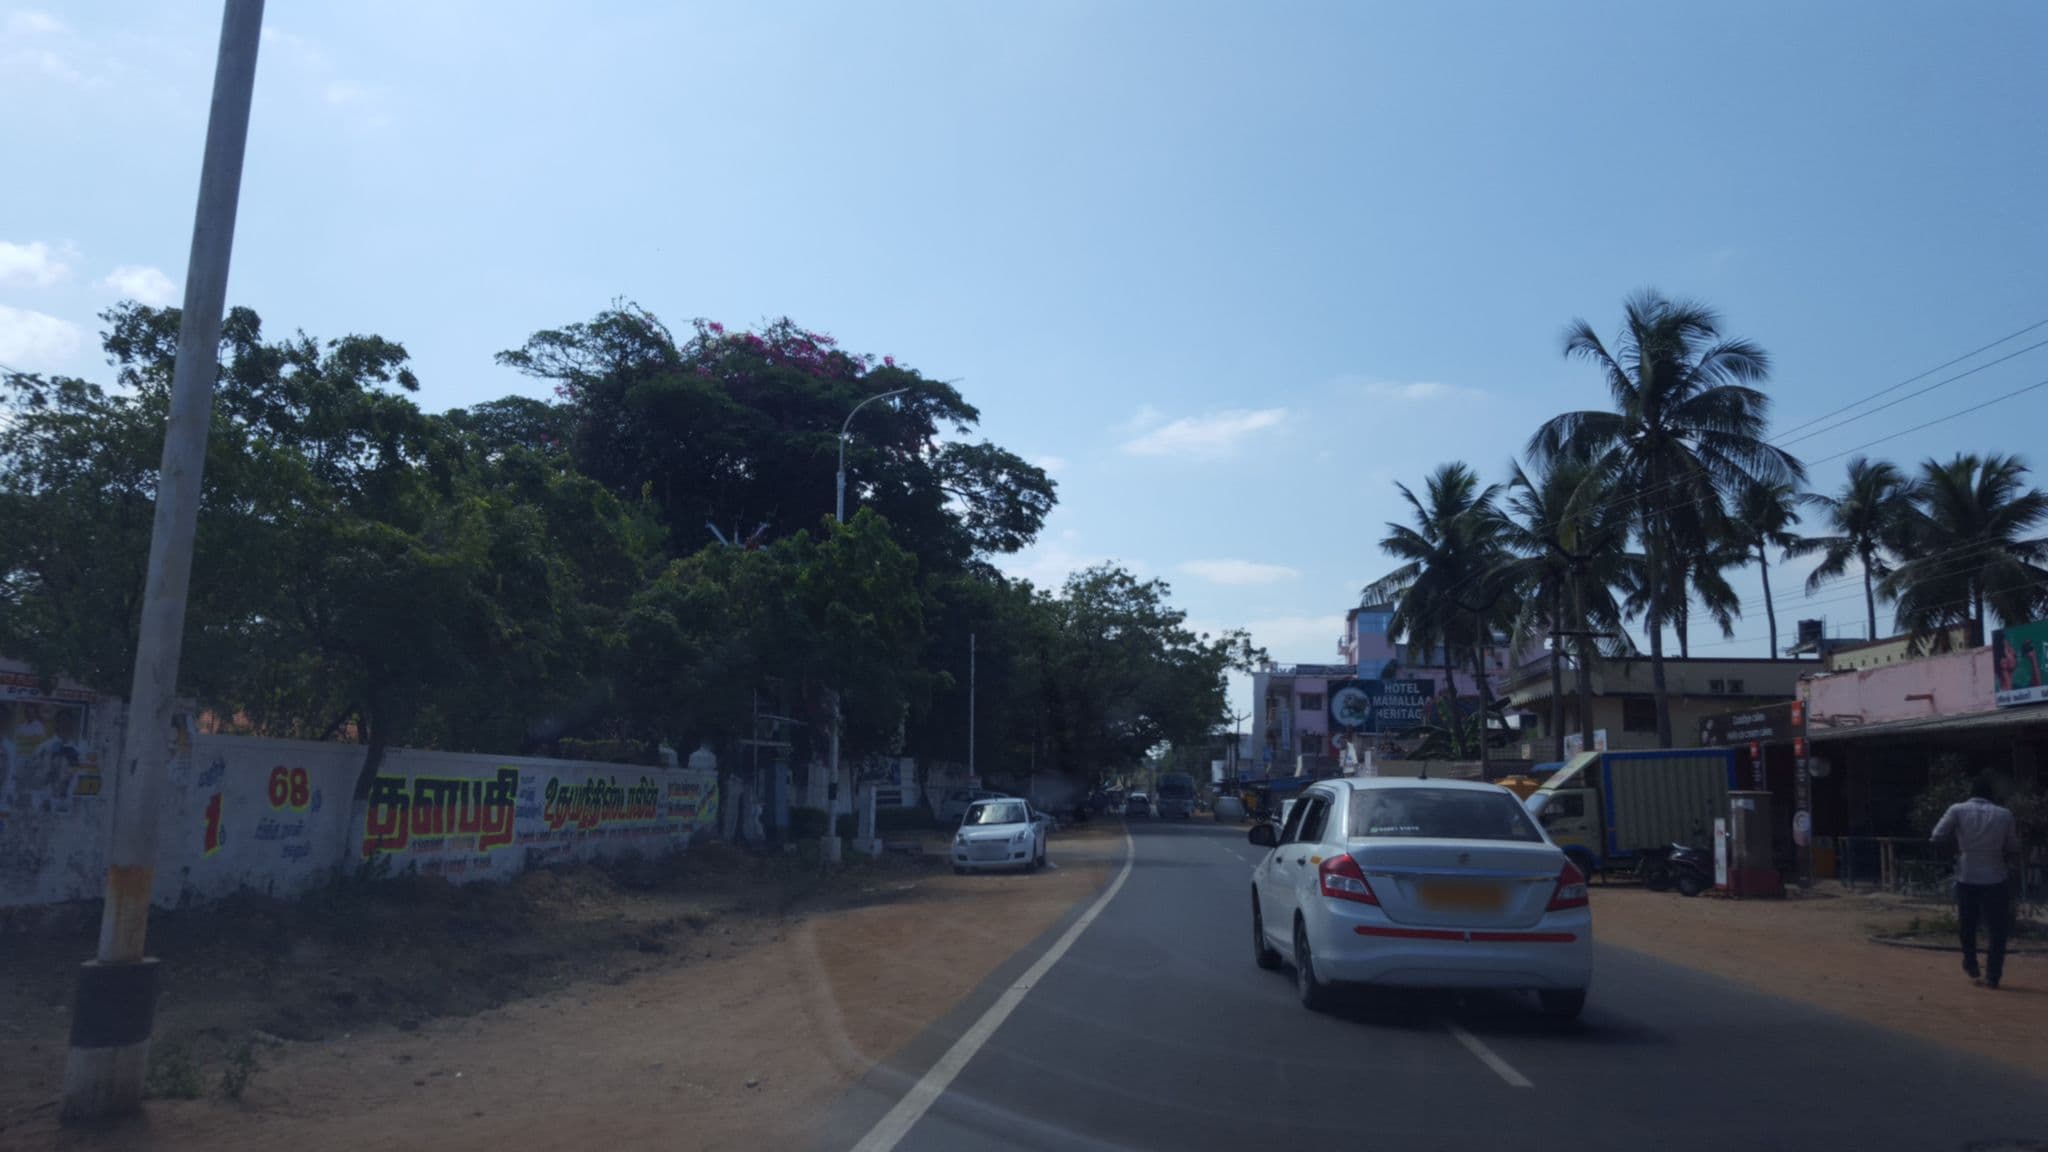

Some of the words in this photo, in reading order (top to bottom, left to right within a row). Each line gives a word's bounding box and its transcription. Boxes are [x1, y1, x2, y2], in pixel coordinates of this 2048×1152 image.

[1384, 682, 1420, 694] HOTEL
[1376, 708, 1425, 720] HERITAG
[268, 765, 311, 810] 68
[362, 765, 520, 858] தளபதி
